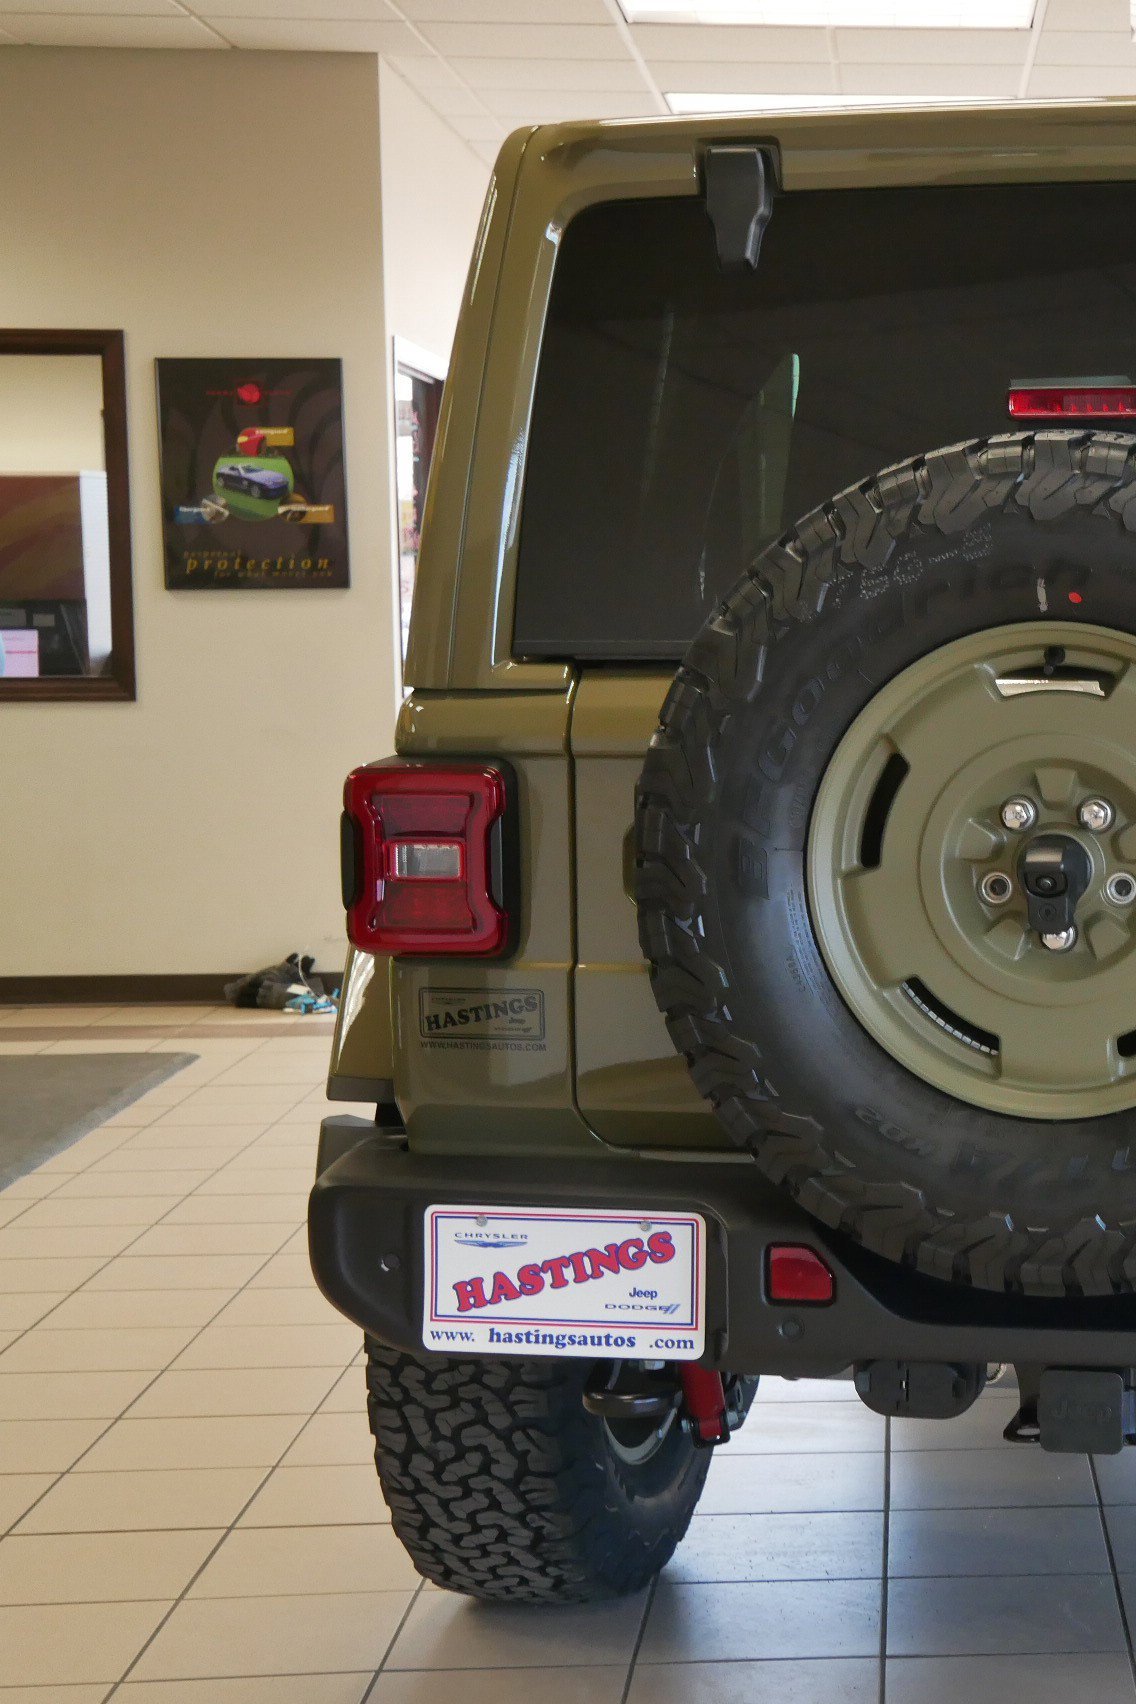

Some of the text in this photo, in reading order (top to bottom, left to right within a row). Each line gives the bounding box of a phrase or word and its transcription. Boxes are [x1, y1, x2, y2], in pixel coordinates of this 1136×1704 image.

[186, 555, 331, 575] protection
[425, 995, 538, 1032] HASTINGS
[454, 1232, 528, 1240] CHRYSLER
[452, 1231, 676, 1312] HASTINGS
[628, 1287, 658, 1300] Jeep
[605, 1303, 669, 1312] DODGE
[488, 1327, 636, 1350] hastingsautos
